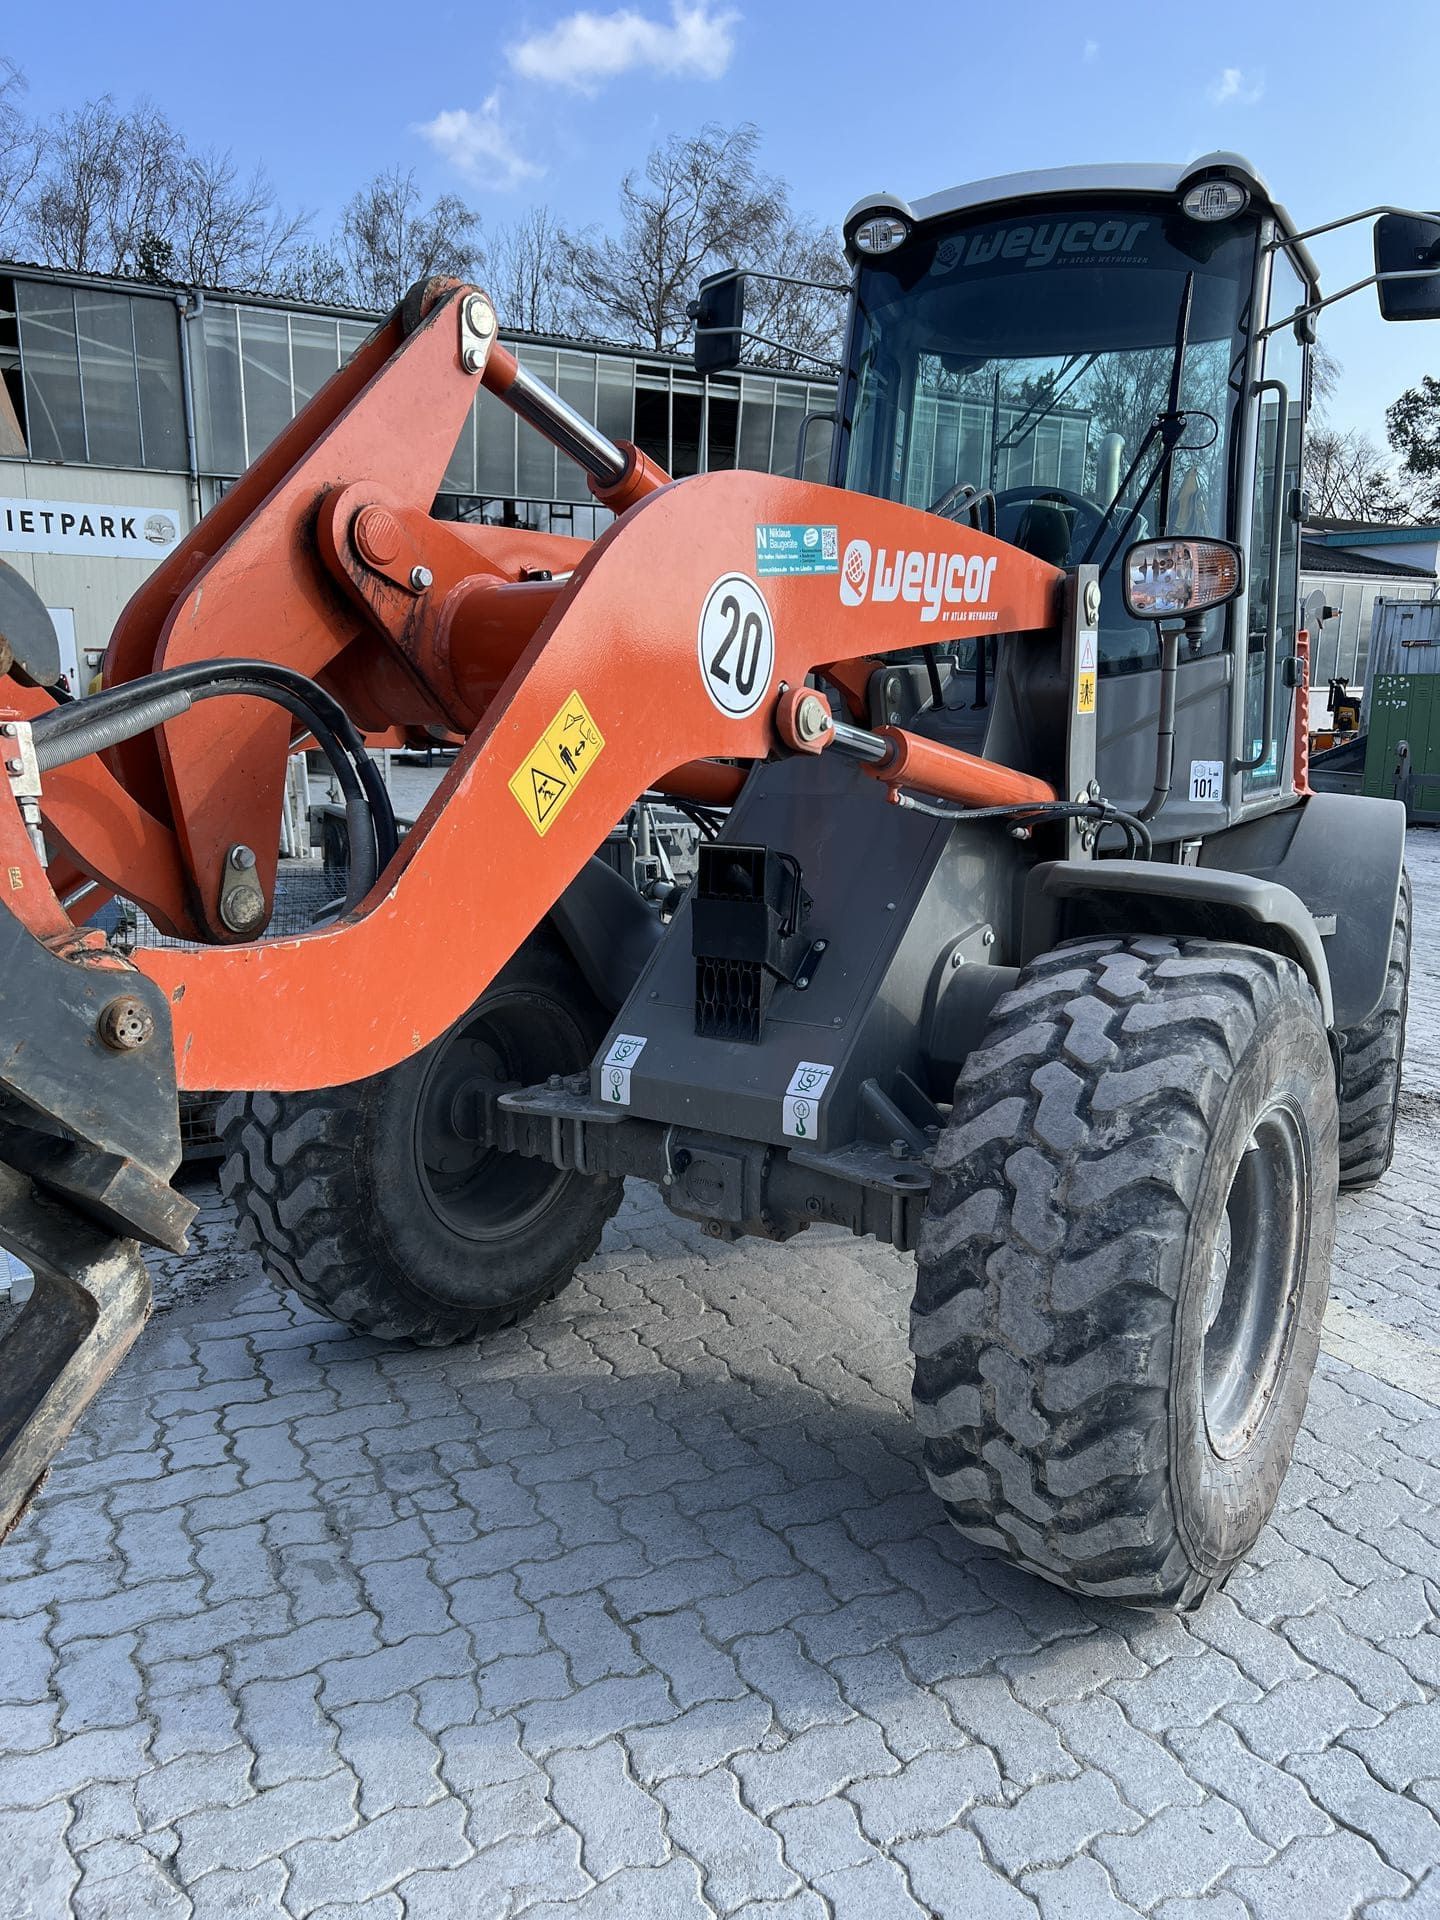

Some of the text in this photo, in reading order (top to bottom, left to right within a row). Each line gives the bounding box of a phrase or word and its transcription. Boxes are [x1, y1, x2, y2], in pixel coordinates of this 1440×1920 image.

[963, 221, 1150, 267] weycor
[1070, 256, 1096, 264] ATLAS
[871, 548, 998, 622] weycor
[951, 611, 967, 621] ATLAS
[710, 595, 763, 696] 20
[1193, 778, 1212, 798] 101
